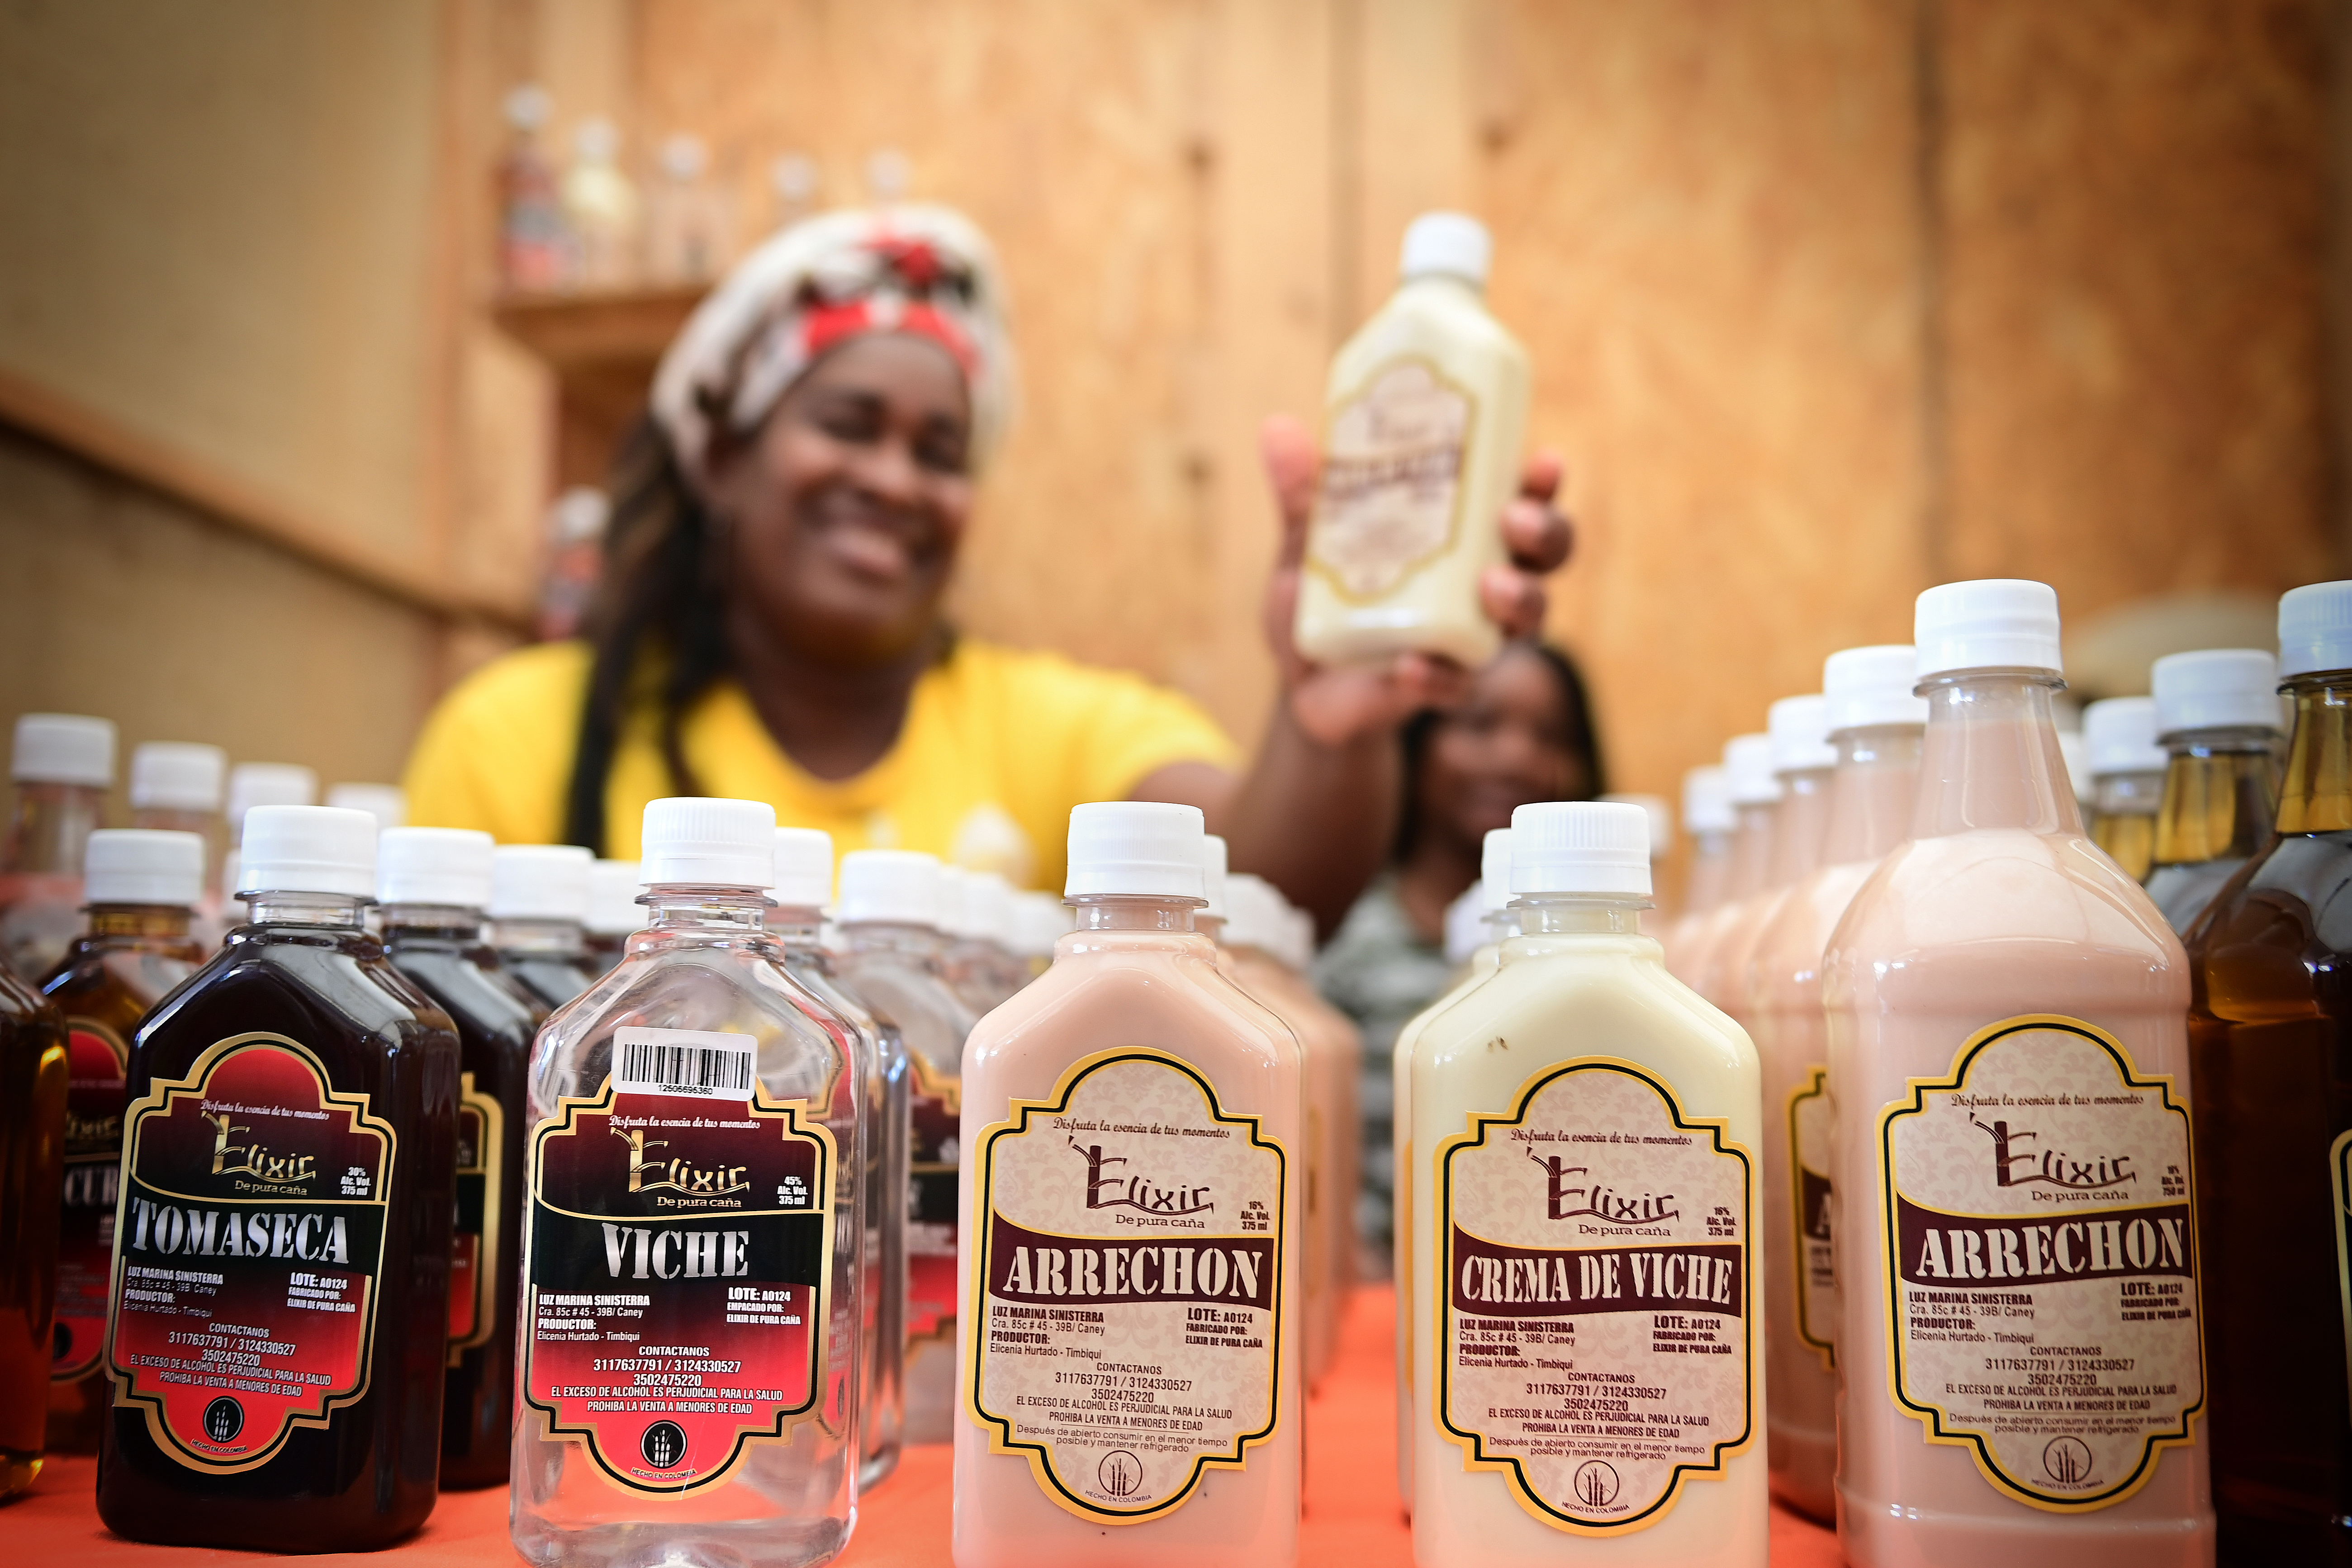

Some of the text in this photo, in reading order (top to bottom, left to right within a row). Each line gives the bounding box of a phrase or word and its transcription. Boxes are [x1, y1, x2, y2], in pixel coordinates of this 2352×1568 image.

[608, 1114, 760, 1129] Disfruta la esencia de tus momentos
[1052, 1116, 1230, 1138] Disfruta la esencia de tus momentos
[201, 1110, 316, 1182] Elixir
[1969, 1112, 2137, 1189] Elixir
[610, 1127, 750, 1197] Elixir
[783, 1175, 802, 1185] 45%
[1068, 1135, 1214, 1216] Elixir
[234, 1180, 307, 1195] De pura caña
[777, 1185, 808, 1195] Alc. Vol.
[1527, 1147, 1679, 1224] Elixir
[656, 1196, 742, 1208] De pura caña
[778, 1195, 805, 1205] 375 ml
[2031, 1189, 2129, 1202] De pura caña
[1115, 1213, 1205, 1228] De pura caña
[133, 1197, 349, 1264] TOMASECA
[1578, 1224, 1671, 1237] De pura caña
[602, 1222, 749, 1279] VICHE
[1915, 1218, 2184, 1279] ARRECHON
[127, 1265, 223, 1284] LUZ MARINA SINISTERRA
[1002, 1246, 1263, 1299] ARRECHON
[1461, 1252, 1733, 1305] CREMA DE VICHE
[289, 1272, 347, 1289] LOTE: A0124
[124, 1289, 175, 1303] PRODUCTOR:
[728, 1287, 791, 1302] LOTE: A0124
[2120, 1282, 2155, 1296] LOTE:
[539, 1293, 650, 1306] LUZ MARINA SINISTERRA
[1909, 1291, 2033, 1305] LUZ MARINA SINISTERRA
[538, 1306, 554, 1316] Cra.
[555, 1307, 570, 1316] 85c
[579, 1307, 589, 1317] 45
[616, 1307, 643, 1319] Caney
[726, 1302, 784, 1312] EMPACADO POR:
[992, 1305, 1104, 1323] LUZ MARINA SINISTERRA
[726, 1313, 801, 1325] ELIXIR DE PURA CAÑA
[1187, 1307, 1253, 1324] LOTE: A0124
[1654, 1315, 1721, 1330] LOTE: A0124
[537, 1317, 597, 1330] PRODUCTOR:
[1459, 1318, 1574, 1334] LUZ MARINA SINISTERRA
[1910, 1317, 1976, 1330] PRODUCTOR:
[168, 1331, 228, 1348] 3117637791
[237, 1338, 296, 1356] 3124330527
[536, 1330, 566, 1341] Elicenia
[567, 1331, 599, 1341] Hurtado
[605, 1331, 640, 1343] Timbiqui
[991, 1330, 1050, 1345] PRODUCTOR:
[201, 1348, 260, 1366] 3502475220
[638, 1345, 709, 1356] CONTACTANOS
[990, 1342, 1022, 1355] Elicenia
[1024, 1344, 1058, 1356] Hurtado
[1065, 1346, 1101, 1360] Timbiqui
[593, 1358, 662, 1371] 3117637791
[673, 1359, 741, 1373] 3124330527
[1096, 1361, 1162, 1375] CONTACTANOS
[1985, 1358, 2055, 1371] 3117637791
[2067, 1358, 2136, 1372] 3124330527
[633, 1373, 702, 1387] 3502475220
[1055, 1372, 1117, 1387] 3117637791
[1129, 1376, 1192, 1392] 3124330527
[1567, 1372, 1635, 1384] CONTACTANOS
[2027, 1373, 2097, 1386] 3502475220
[551, 1386, 782, 1400] EL EXCESO DE ALCOHOL ES PERJUDICIAL PARA LA SALUD
[1091, 1388, 1154, 1403] 3502475220
[1526, 1383, 1589, 1396] 3117637791
[1601, 1385, 1667, 1399] 3124330527
[587, 1400, 752, 1414] PROHIBA LA VENTA A MENORES DE EDAD
[1563, 1398, 1628, 1412] 3502475220
[1017, 1424, 1055, 1435] Después
[1071, 1429, 1100, 1438] abierto
[1103, 1432, 1143, 1441] consumir
[1158, 1435, 1166, 1443] el
[1198, 1437, 1228, 1448] tiempo
[1056, 1437, 1189, 1453] posible y mantener refrigerado
